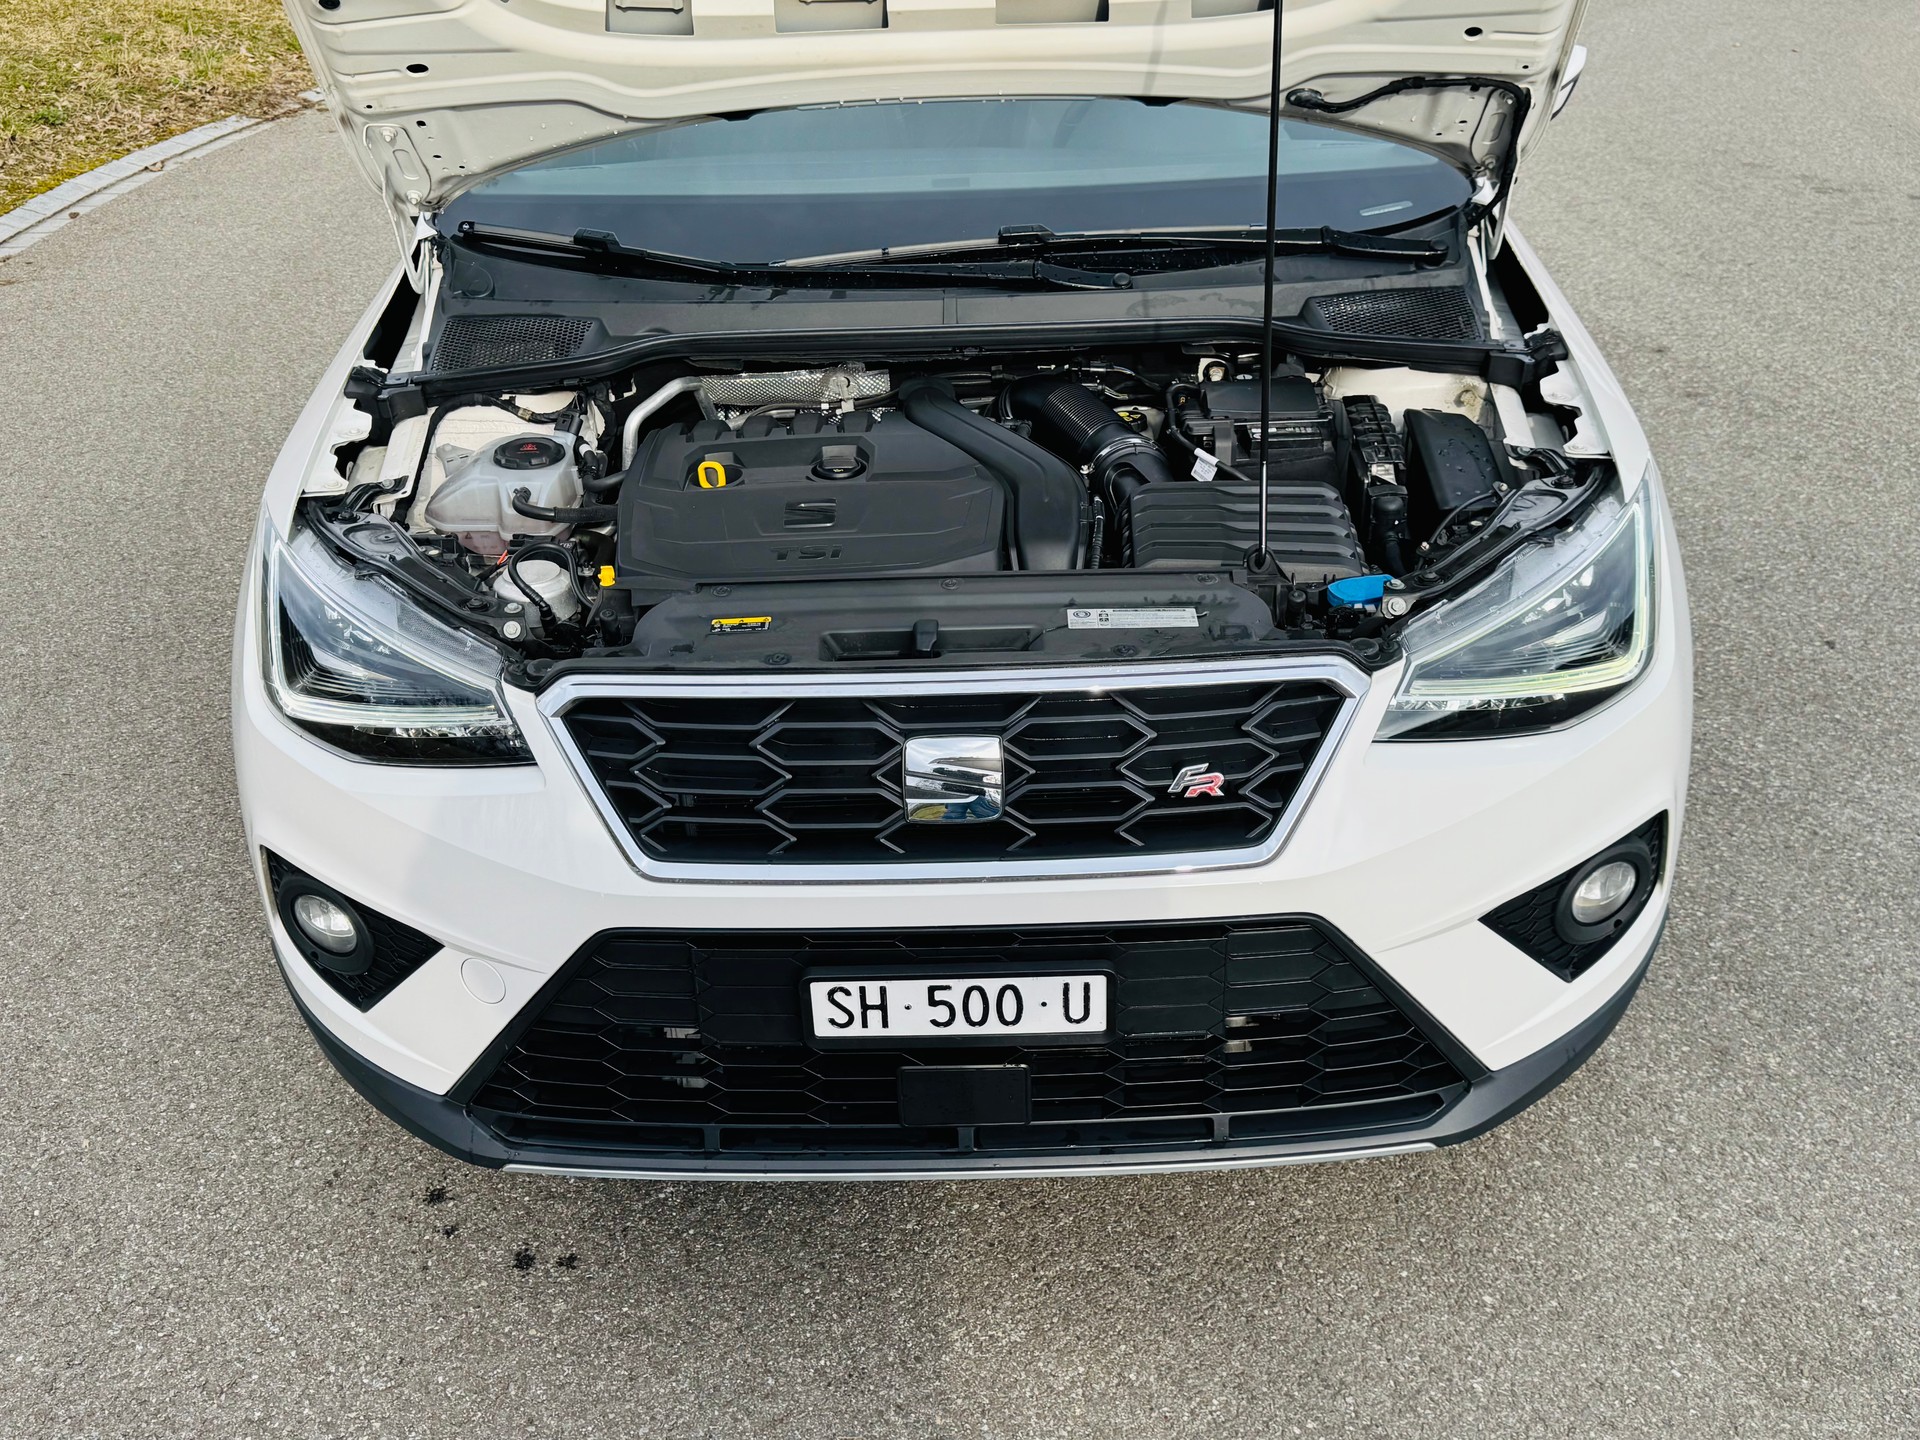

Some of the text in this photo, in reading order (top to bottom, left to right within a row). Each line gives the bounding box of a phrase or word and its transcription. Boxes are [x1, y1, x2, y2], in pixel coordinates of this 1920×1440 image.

[769, 543, 843, 561] TSI
[1167, 762, 1225, 798] FR
[826, 981, 1092, 1029] SH 500 U
